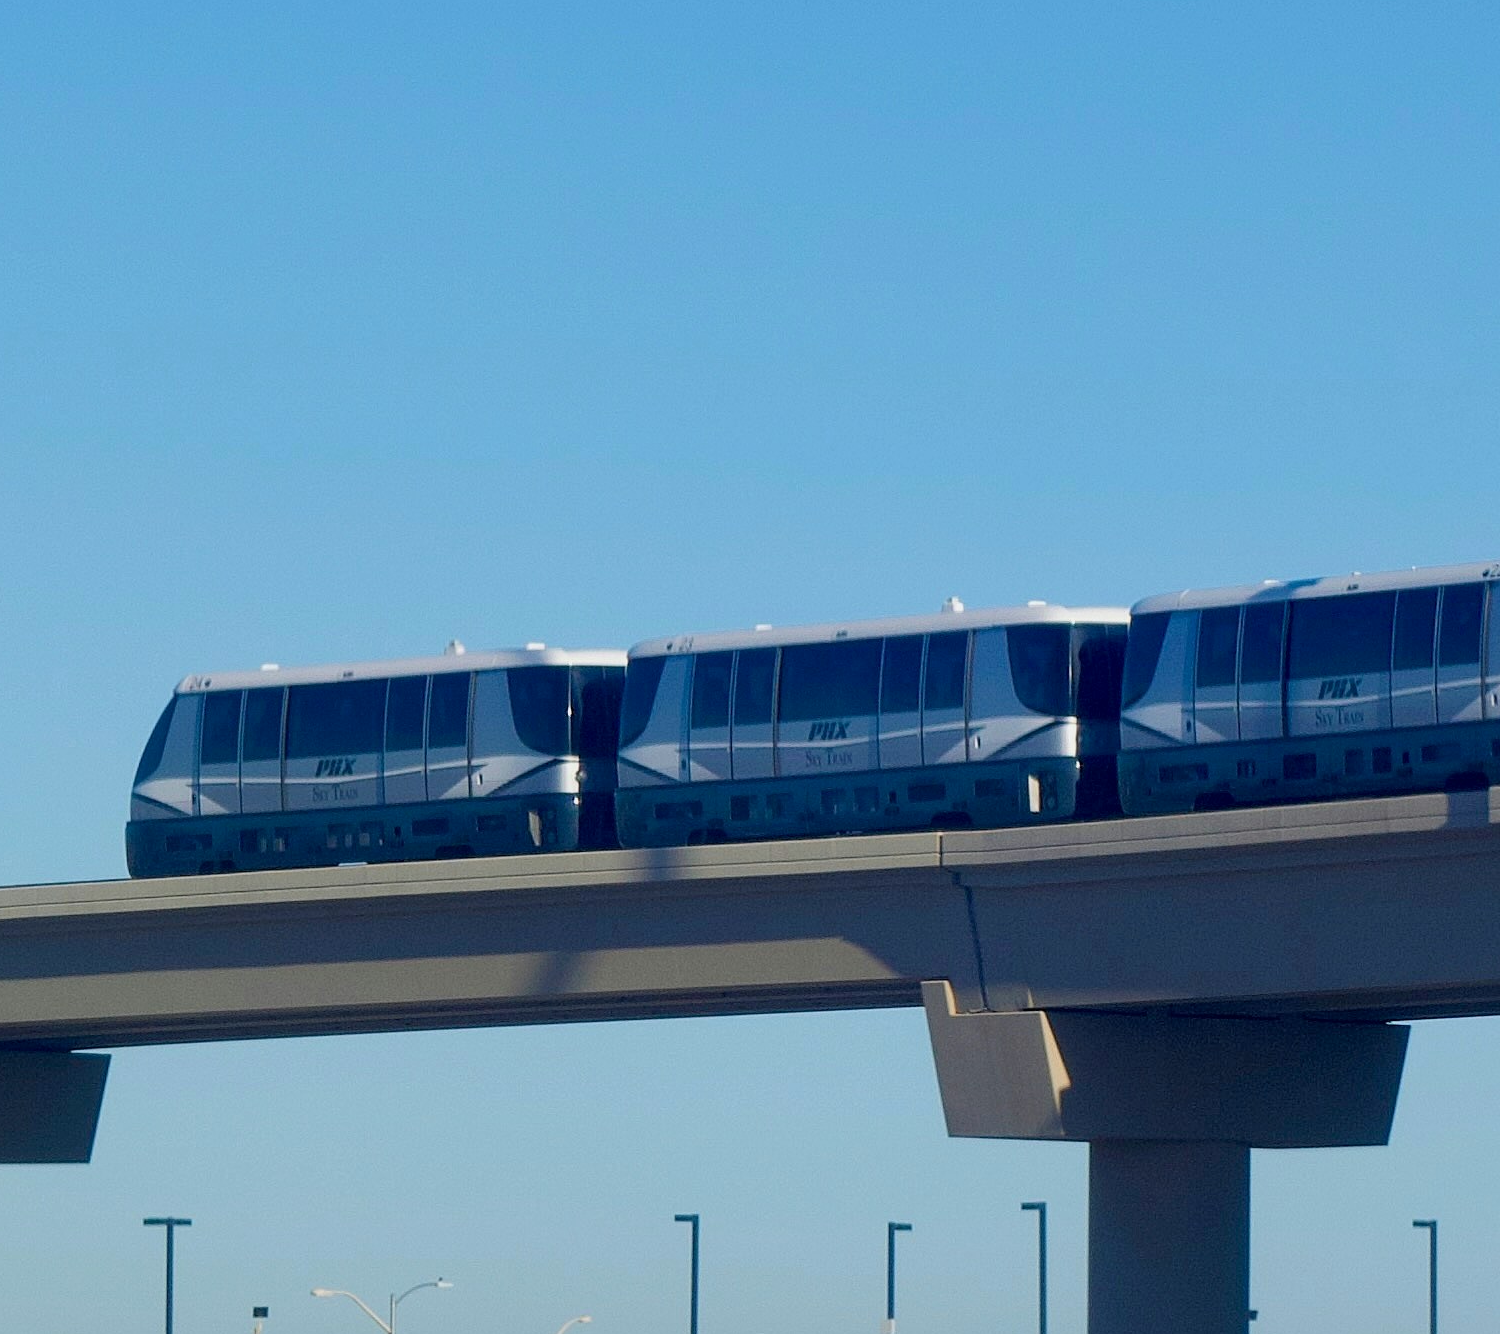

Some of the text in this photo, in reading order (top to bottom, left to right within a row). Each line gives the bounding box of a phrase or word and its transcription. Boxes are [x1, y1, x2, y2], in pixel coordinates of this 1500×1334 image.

[1318, 677, 1363, 700] PHX
[808, 720, 850, 742] PHX
[315, 758, 357, 778] PHX
